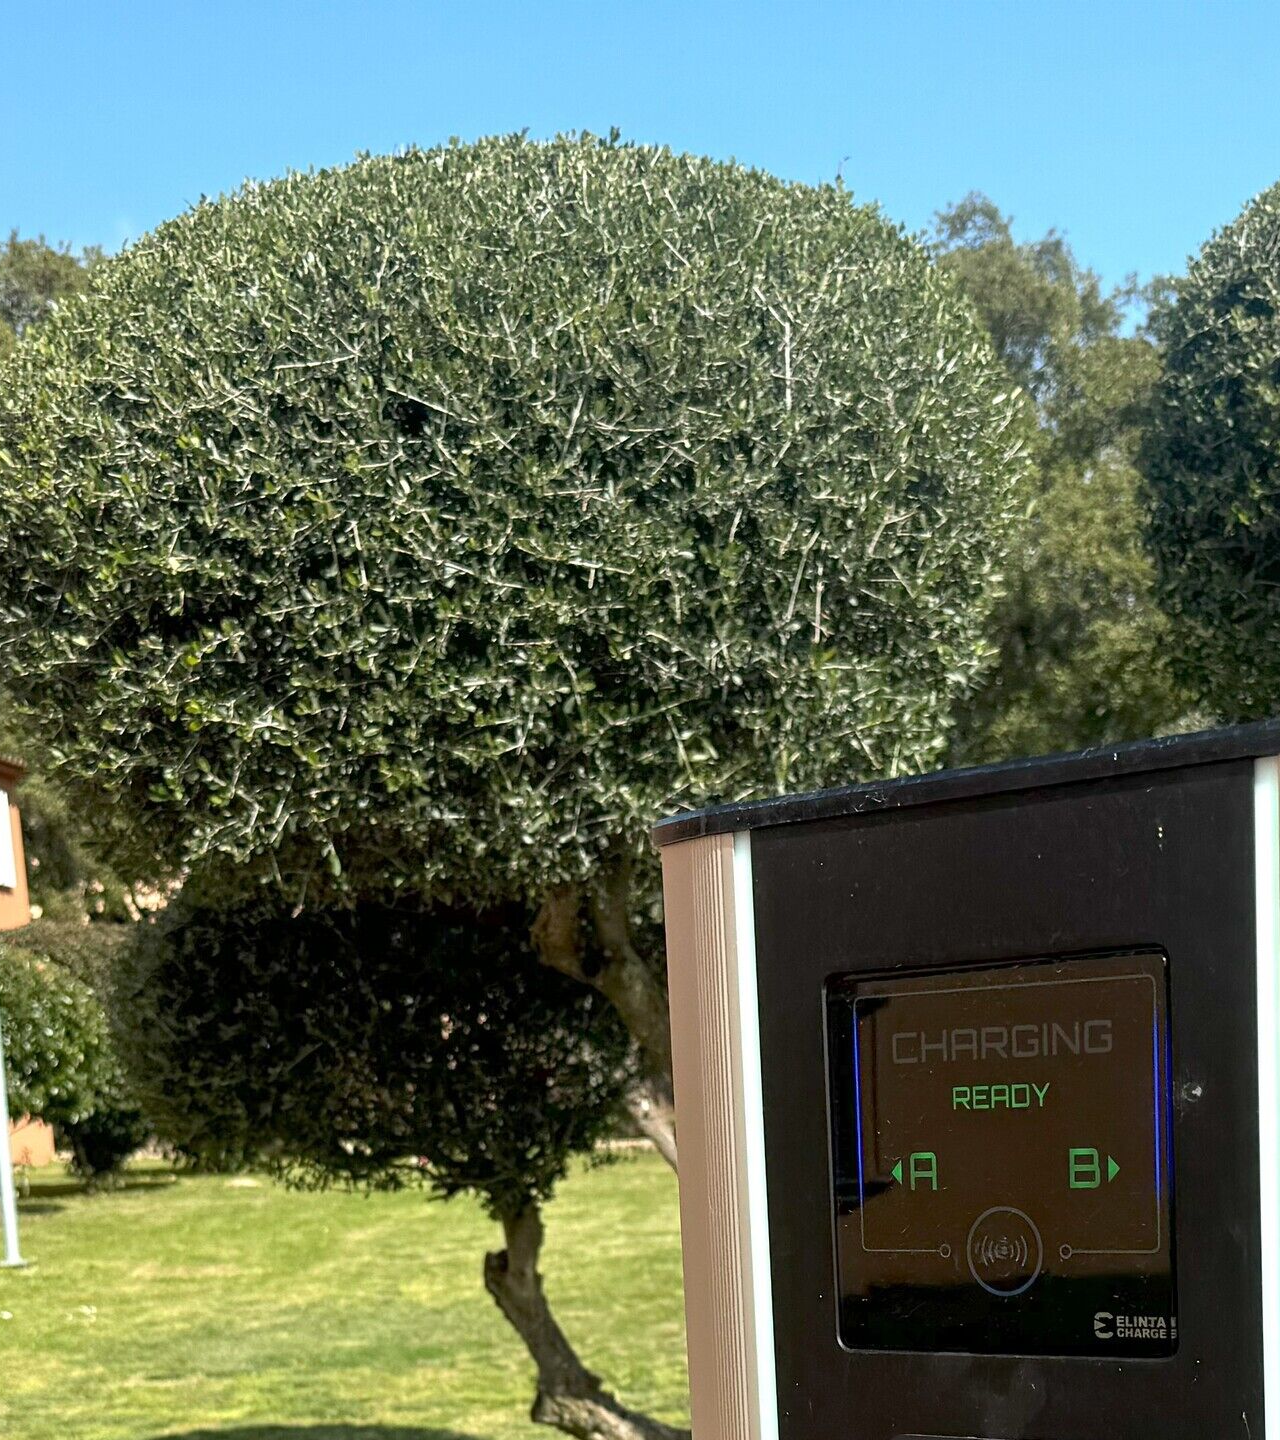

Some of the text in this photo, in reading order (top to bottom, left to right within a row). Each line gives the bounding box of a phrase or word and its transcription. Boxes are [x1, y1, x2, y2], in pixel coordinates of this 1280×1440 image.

[892, 1019, 1113, 1065] CHARGING
[952, 1083, 1050, 1110] READY
[909, 1151, 938, 1190] A
[1069, 1148, 1101, 1189] B
[1116, 1315, 1166, 1328] ELINTA
[1116, 1327, 1167, 1339] CHARGE
